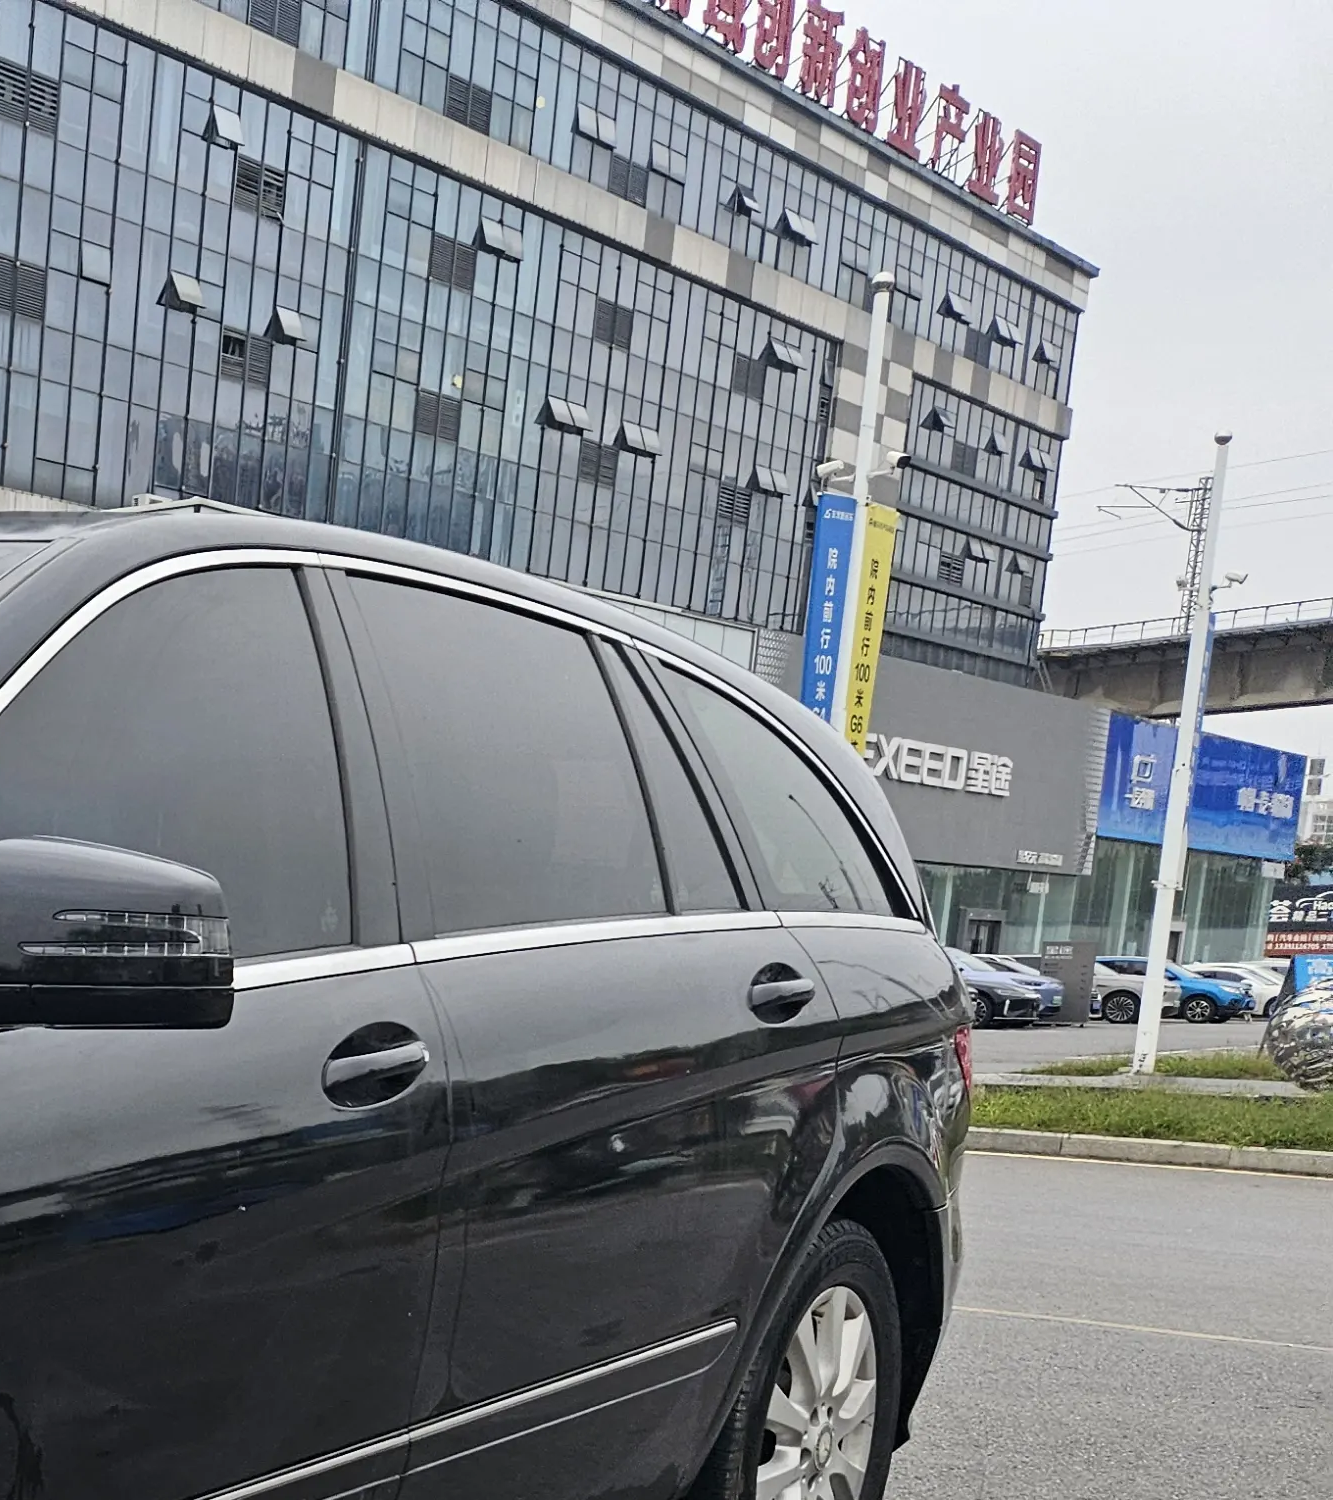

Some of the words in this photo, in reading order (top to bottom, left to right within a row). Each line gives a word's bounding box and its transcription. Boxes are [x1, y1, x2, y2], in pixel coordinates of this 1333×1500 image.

[660, 0, 1043, 226] 创新创业产业园
[965, 751, 1014, 798] 星途
